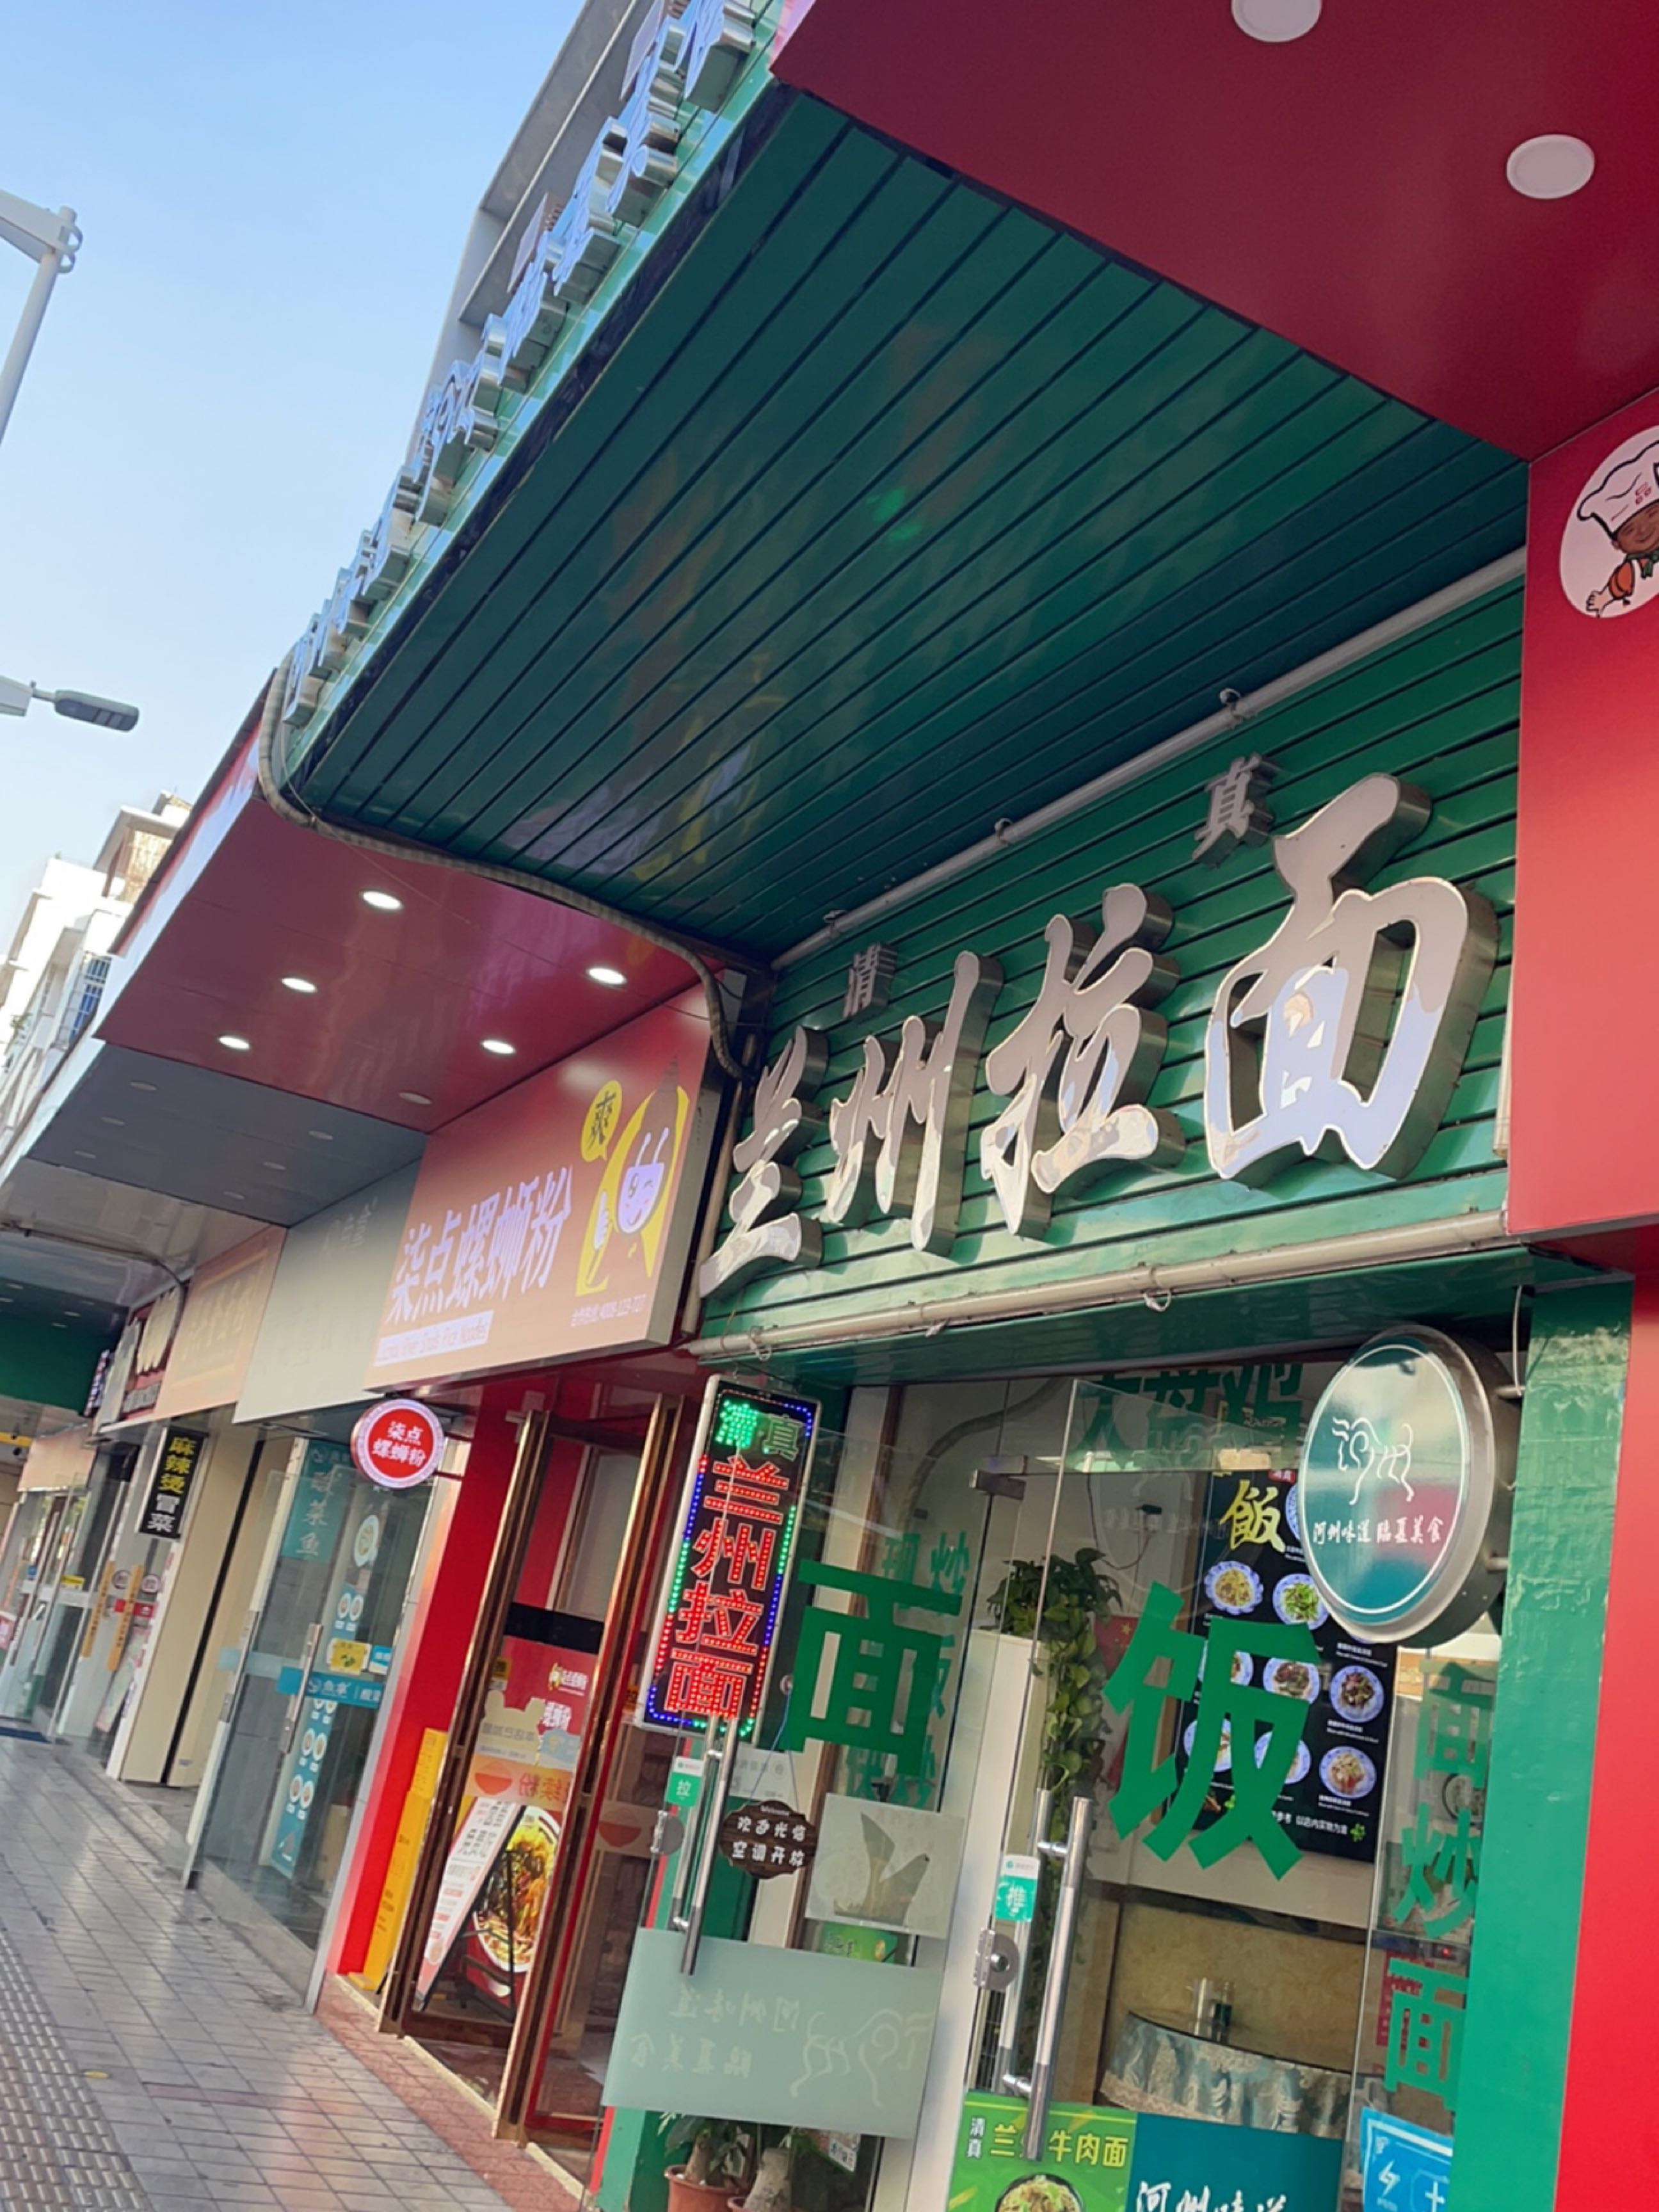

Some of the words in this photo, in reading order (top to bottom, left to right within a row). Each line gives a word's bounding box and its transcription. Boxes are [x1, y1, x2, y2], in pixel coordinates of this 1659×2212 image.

[1192, 754, 1262, 861] 真
[700, 773, 1471, 1299] 兰州拉面
[663, 1455, 790, 1719] 兰州拉面
[777, 1558, 963, 1779] 面
[1102, 1580, 1321, 1882] 饭
[966, 2117, 986, 2159] 清真
[990, 2123, 1129, 2168] 兰牛肉面
